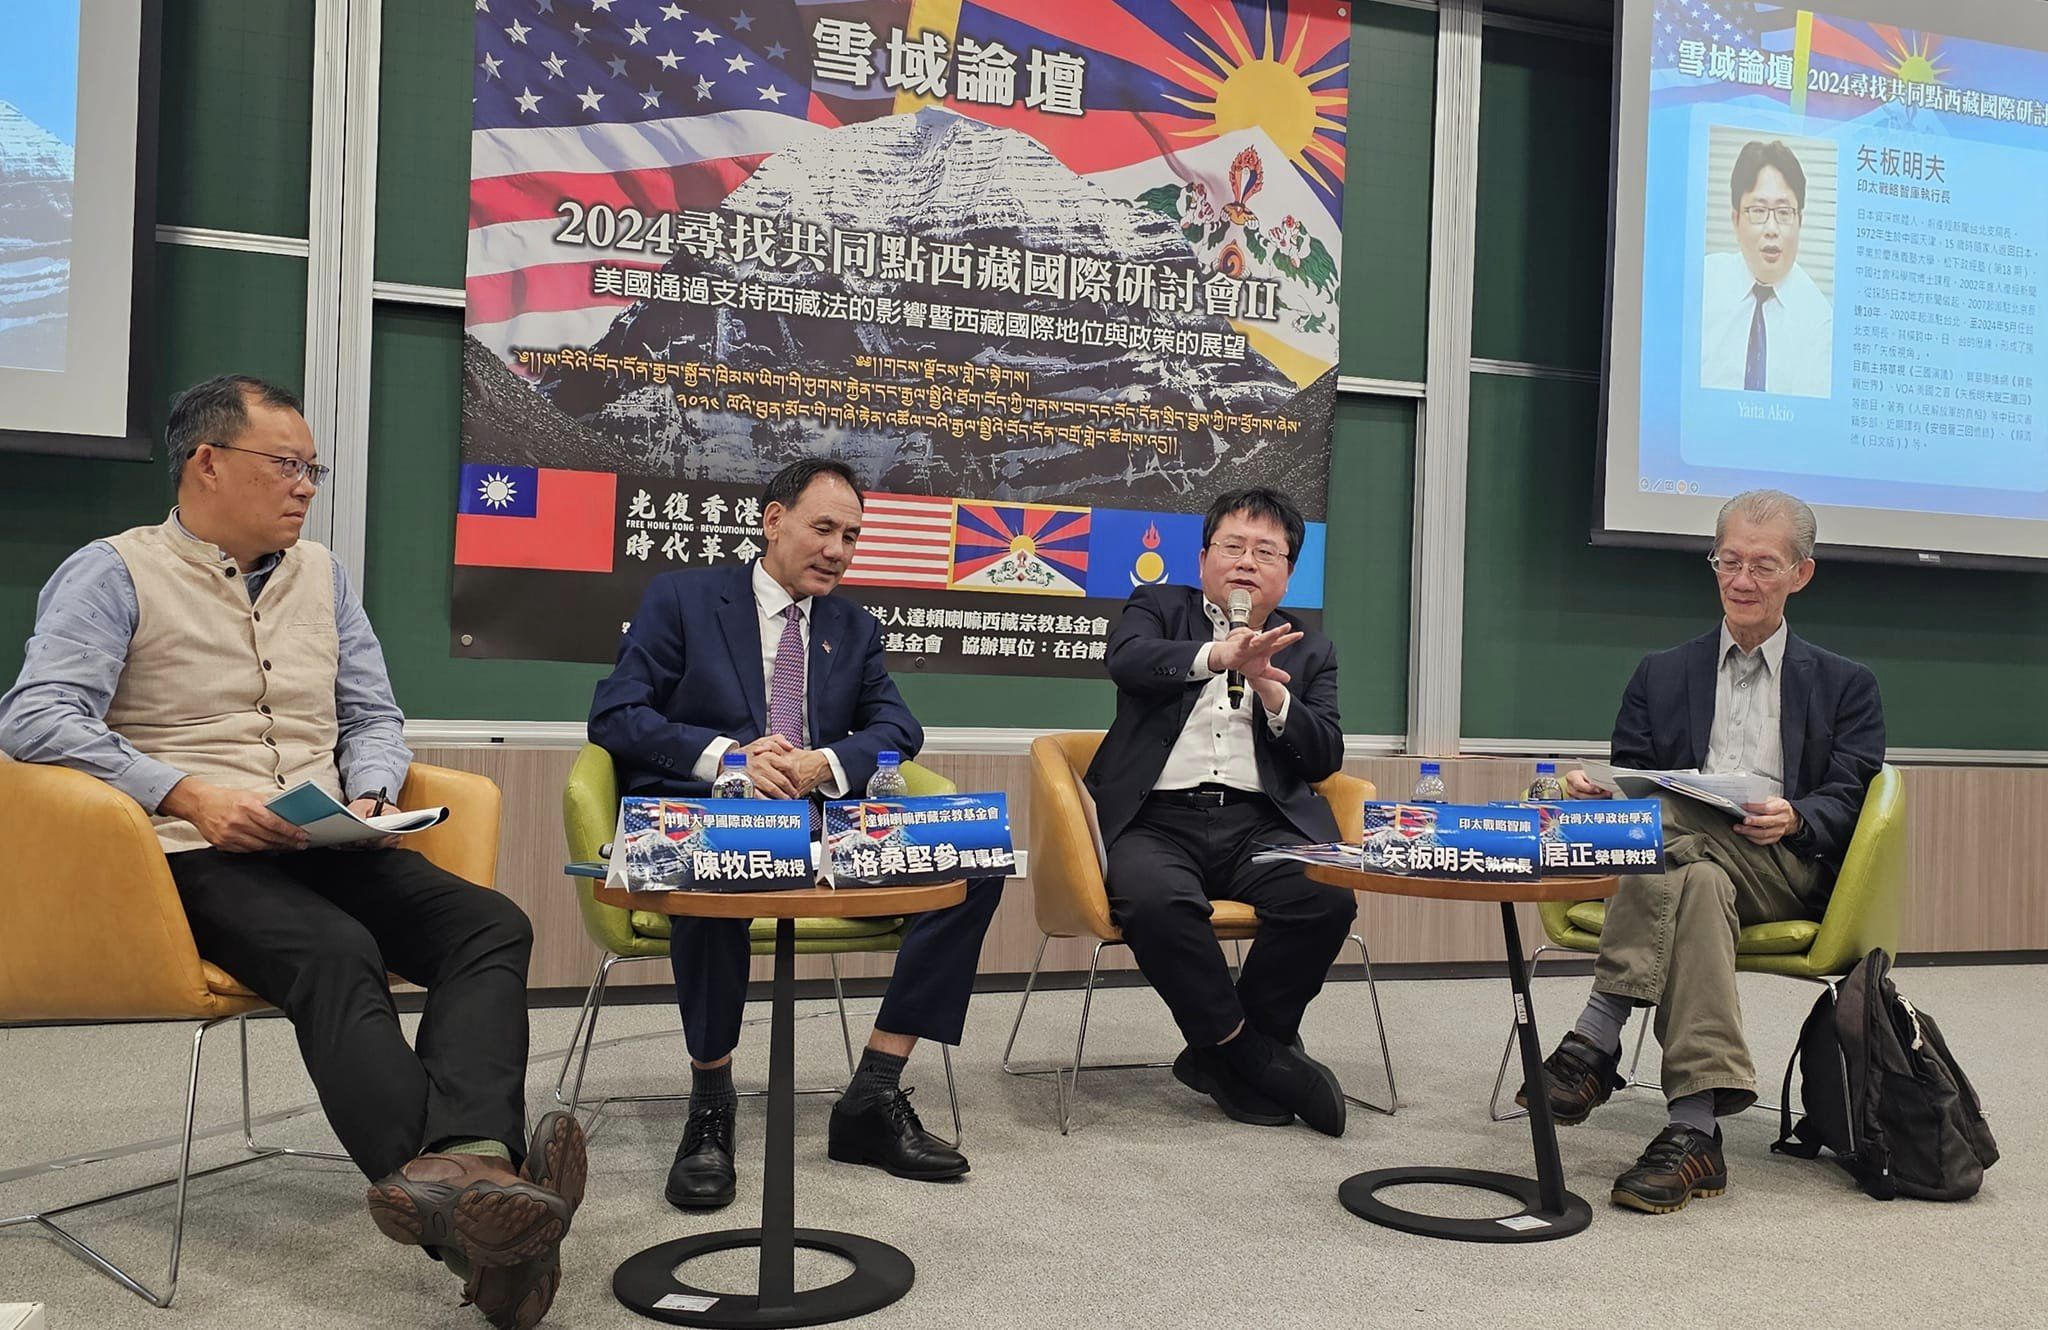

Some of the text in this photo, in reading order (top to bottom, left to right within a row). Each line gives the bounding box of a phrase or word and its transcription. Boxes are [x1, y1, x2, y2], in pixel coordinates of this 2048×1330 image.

[812, 17, 1085, 116] 雪域論壇
[1678, 39, 1794, 91] 雪域論壇
[1857, 144, 1945, 183] 矢板明夫
[1857, 179, 1950, 204] 印太戰略智庫執行長
[594, 266, 1246, 360] 美國通過支持西藏法的影響暨西藏國際地位與政策的展望
[1737, 400, 1795, 422] Yaita Akio
[628, 489, 762, 526] 光復香港
[626, 519, 764, 536] FREE HONG KONG REVOLUTION NOW
[625, 530, 762, 565] 時代革命
[862, 606, 1109, 636] 法人達賴喇嘛西藏宗教基金會
[880, 633, 943, 654] 基金會
[664, 814, 800, 829] 中興大學國際政治研究所
[1459, 818, 1531, 832] 印太戰略智庫
[1559, 811, 1653, 824] 台灣大學政治學系
[693, 850, 806, 881] 陳牧民教授
[1540, 842, 1657, 867] 居正榮譽教授
